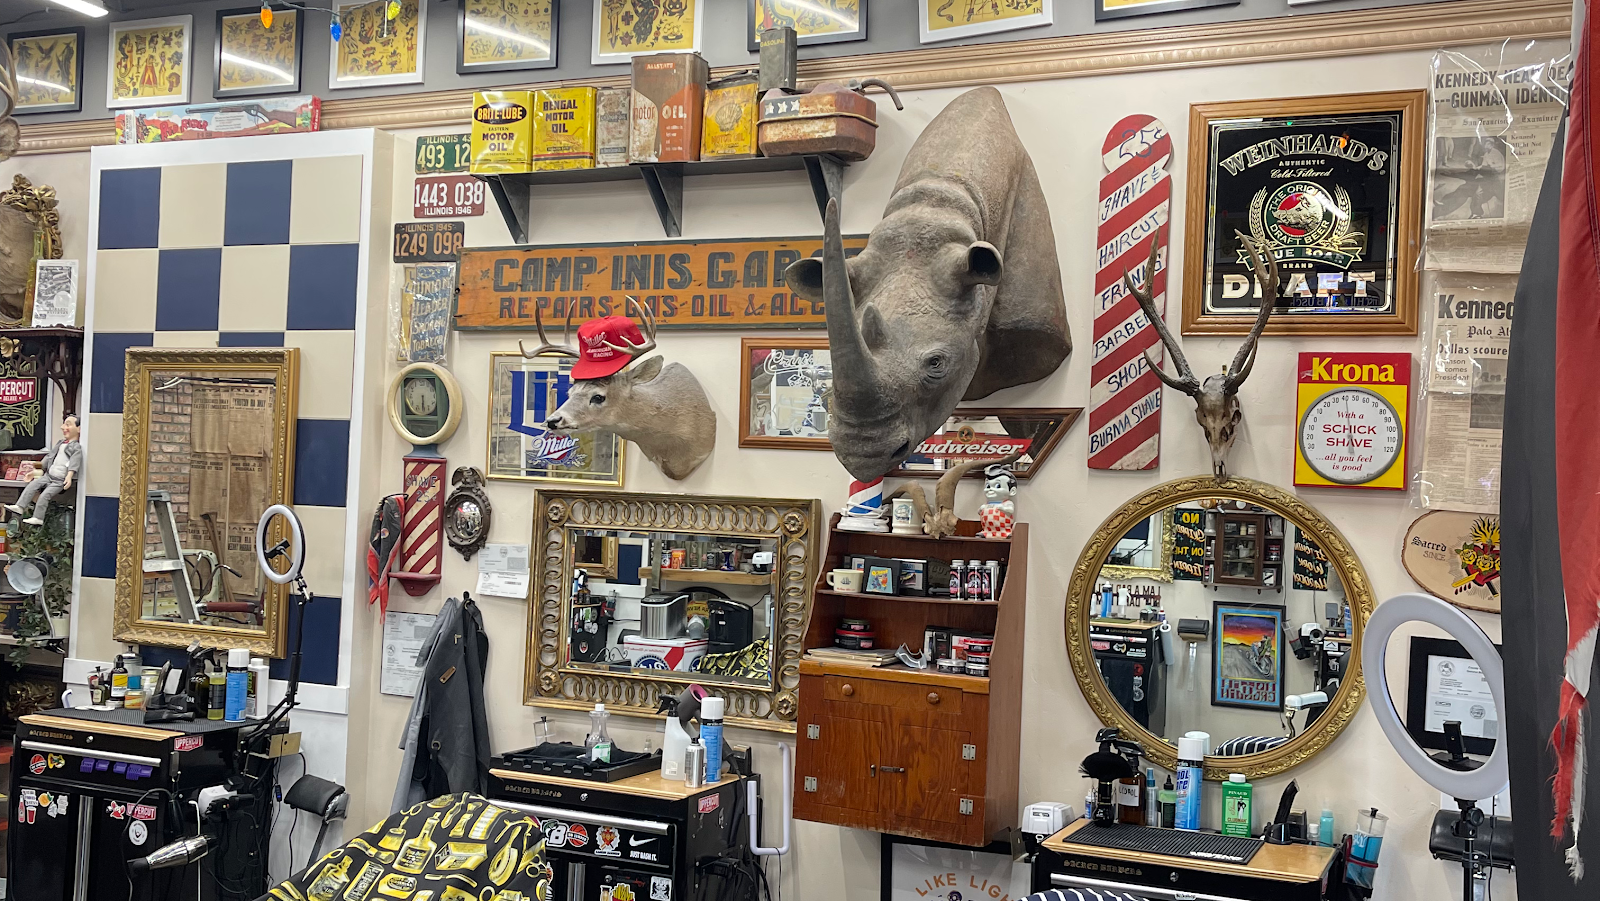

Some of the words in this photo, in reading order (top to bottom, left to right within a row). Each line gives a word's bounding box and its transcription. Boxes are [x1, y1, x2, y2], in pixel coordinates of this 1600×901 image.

[760, 38, 785, 47] GASOLINE
[1436, 70, 1498, 88] KENNEDY
[543, 99, 578, 111] BENGAL
[477, 107, 523, 120] BRITE-LUBE
[545, 111, 574, 121] MOTOR
[1521, 115, 1558, 123] Examiner
[551, 123, 568, 133] OIL
[427, 135, 458, 144] ILLINOIS
[488, 143, 507, 151] OIL
[416, 144, 445, 168] 493
[455, 143, 470, 167] 12
[1219, 134, 1388, 176] WEINHARD'S
[414, 182, 448, 207] 1443
[454, 181, 484, 206] 038
[1101, 174, 1148, 221] SHAVE
[1269, 190, 1286, 211] THE
[424, 206, 453, 215] ILLINOIS
[455, 206, 471, 214] 1946
[405, 223, 434, 232] ILLINOIS
[436, 223, 452, 231] 1945
[1270, 223, 1302, 245] DRAFT
[1304, 220, 1330, 244] BEER
[394, 233, 428, 257] 1249
[433, 231, 463, 255] 098
[1099, 211, 1159, 268] HAIRCUT
[416, 277, 450, 294] UNION
[415, 297, 448, 316] LEADER
[744, 293, 767, 317] &
[1466, 325, 1492, 338] Palo
[593, 350, 613, 358] RACING
[1107, 356, 1150, 393] SHOP
[1311, 357, 1395, 382] Krona
[507, 371, 573, 437] Lit
[1090, 414, 1132, 453] BURMA
[1131, 391, 1161, 423] SHAVE
[1337, 411, 1356, 419] With
[1322, 424, 1377, 435] SCHICK
[532, 436, 579, 460] Miller
[1326, 438, 1373, 448] SHAVE
[1357, 455, 1373, 463] feel
[1342, 464, 1362, 472] good
[406, 475, 437, 487] SHAVE
[1411, 536, 1447, 552] Sacred
[1423, 551, 1446, 561] SINCE
[915, 873, 957, 897] LIKE
